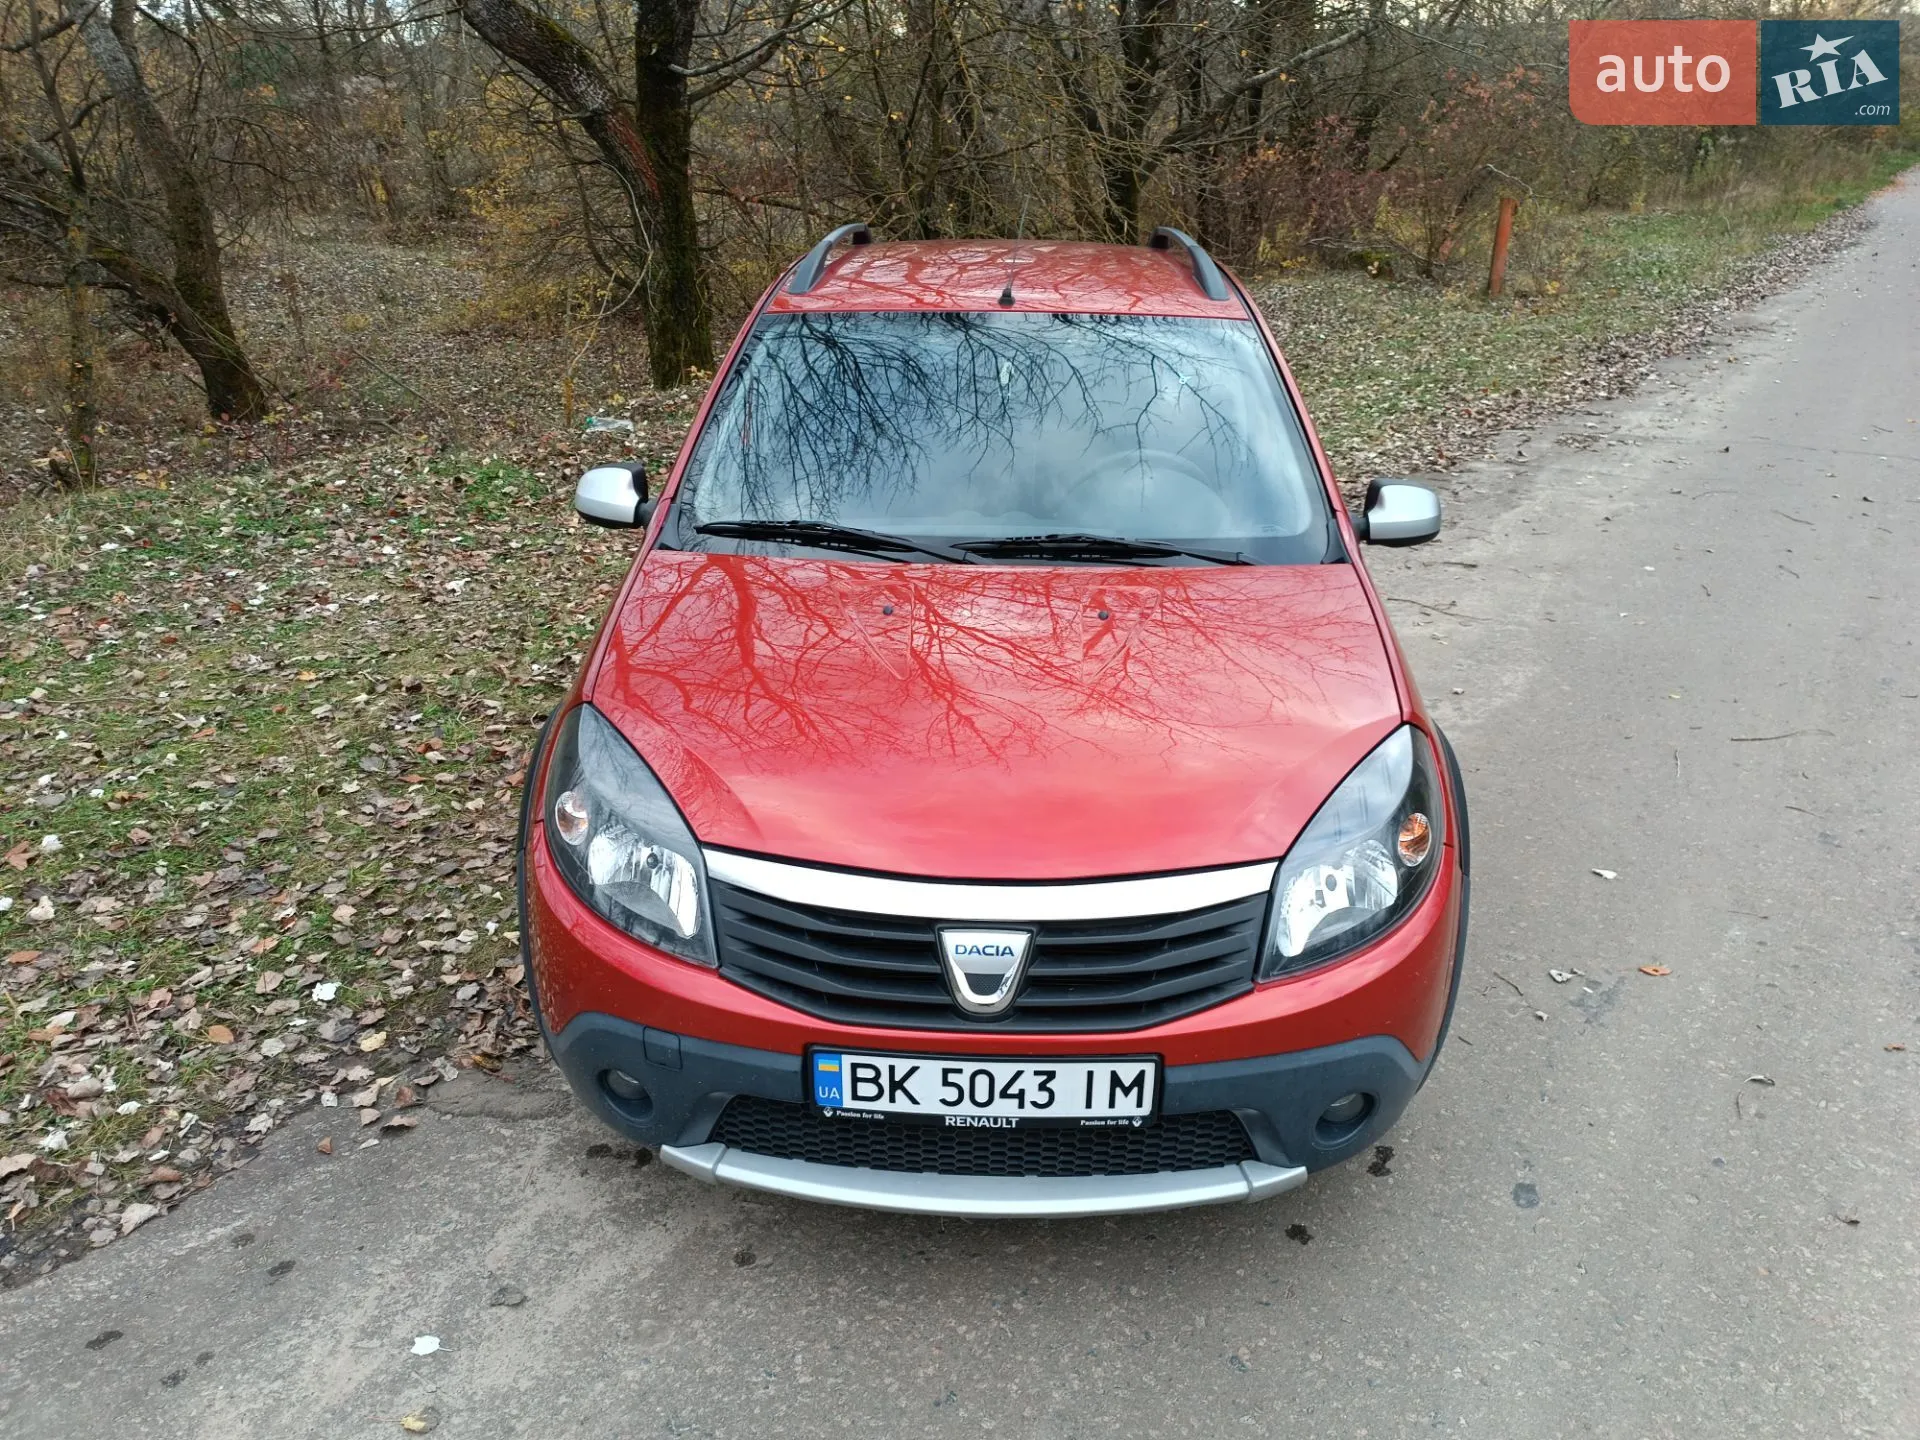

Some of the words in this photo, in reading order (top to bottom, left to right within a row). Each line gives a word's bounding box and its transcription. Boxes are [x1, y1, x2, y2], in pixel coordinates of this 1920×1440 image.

[955, 944, 1015, 957] DACIA
[850, 1062, 921, 1105] BK
[939, 1067, 1057, 1110] 5043
[1085, 1069, 1146, 1109] IM
[818, 1086, 840, 1100] UA
[836, 1110, 861, 1118] Passion
[944, 1115, 1020, 1128] RENAULT
